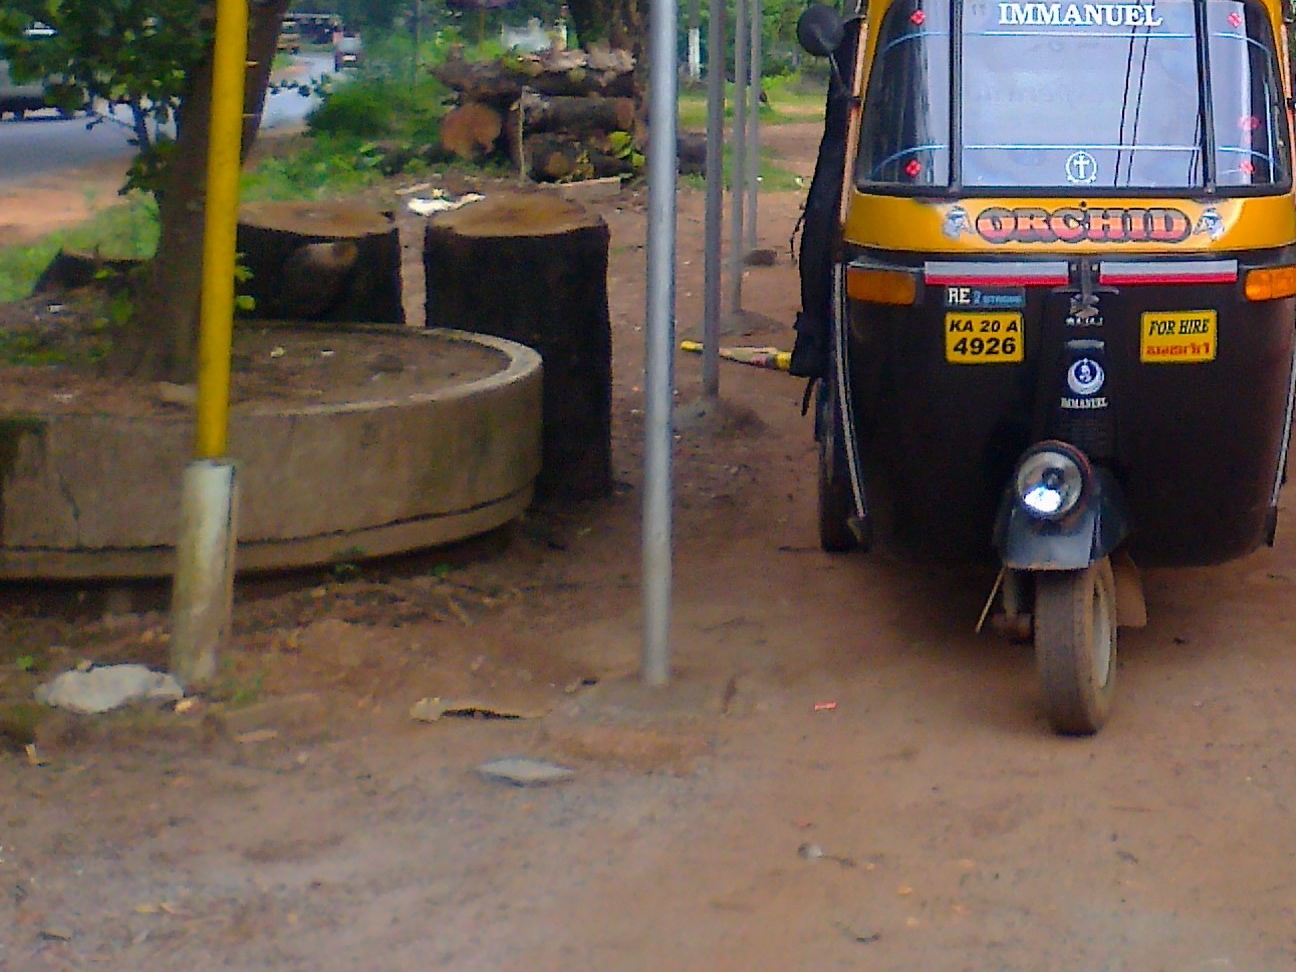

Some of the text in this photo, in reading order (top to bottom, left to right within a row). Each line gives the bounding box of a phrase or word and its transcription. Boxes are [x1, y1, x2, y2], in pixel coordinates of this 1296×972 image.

[998, 2, 1164, 27] IMMANUEL
[976, 207, 1192, 244] ORCHID
[949, 319, 1019, 333] KA 20 A
[1149, 318, 1210, 336] FOR HIRE
[953, 336, 1017, 356] 4926
